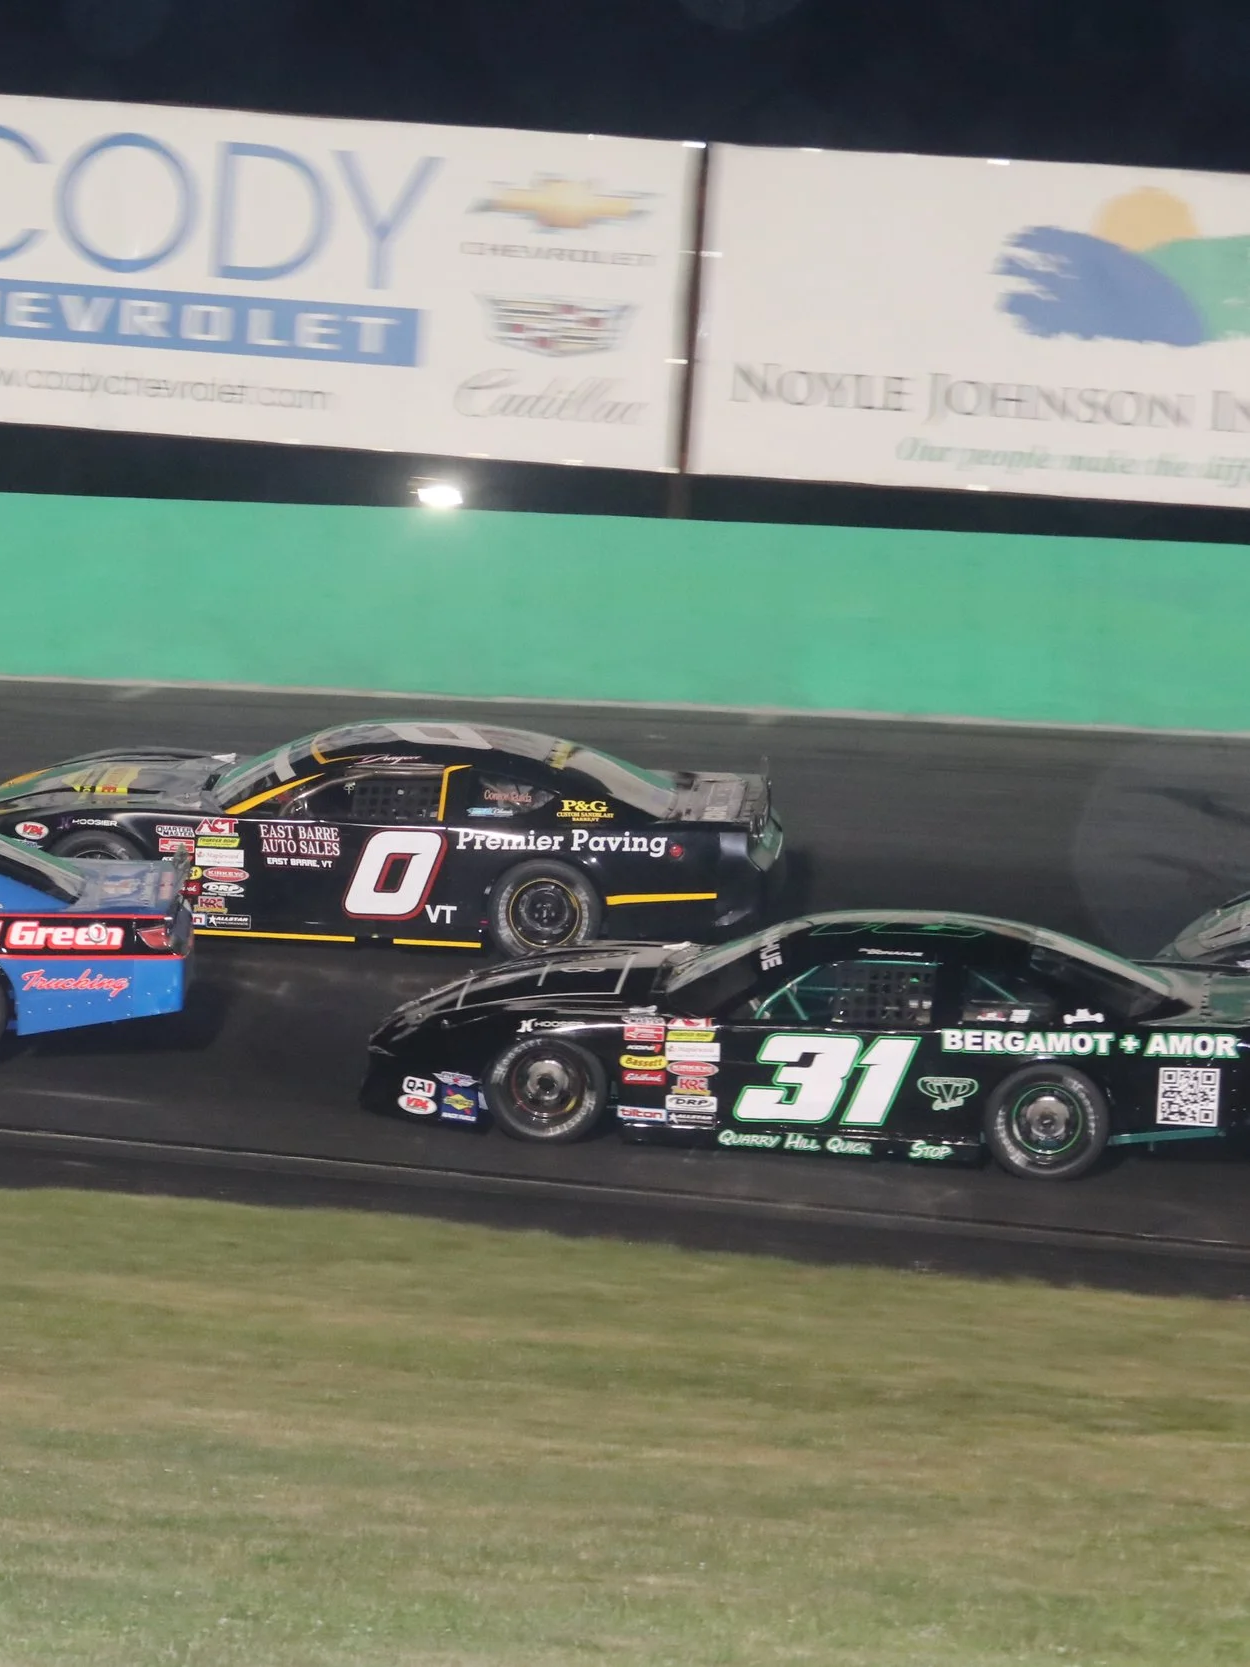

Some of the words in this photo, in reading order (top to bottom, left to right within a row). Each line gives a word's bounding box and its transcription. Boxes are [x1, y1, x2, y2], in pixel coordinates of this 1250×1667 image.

[730, 363, 912, 412] NOYLE
[922, 372, 1196, 429] JOHNSON
[561, 799, 608, 812] P&G
[71, 818, 118, 828] HOOSIER
[196, 818, 238, 835] ACT
[259, 824, 293, 839] EAST
[298, 825, 340, 842] BARRE
[261, 839, 297, 854] AUTO
[299, 840, 341, 857] SALES
[456, 829, 564, 851] Premier
[571, 829, 668, 858] Paving
[266, 857, 288, 866] EAST
[290, 858, 319, 868] BARRE,
[321, 860, 333, 869] VT
[343, 829, 445, 918] 0
[200, 898, 223, 909] KRC
[425, 904, 457, 925] VT
[8, 920, 124, 949] Green
[22, 968, 130, 999] Trucking
[943, 1029, 1116, 1055] BERGAMOT
[1144, 1034, 1238, 1058] AMOR
[625, 1057, 664, 1067] Bassett
[406, 1079, 433, 1093] QA1
[680, 1079, 708, 1091] KRC
[734, 1033, 921, 1126] 31
[676, 1098, 708, 1106] DRP
[620, 1108, 663, 1119] tilton
[718, 1129, 782, 1149] QUARRY
[784, 1133, 821, 1151] HILL
[825, 1137, 872, 1156] QUICK
[909, 1139, 954, 1160] STOP
